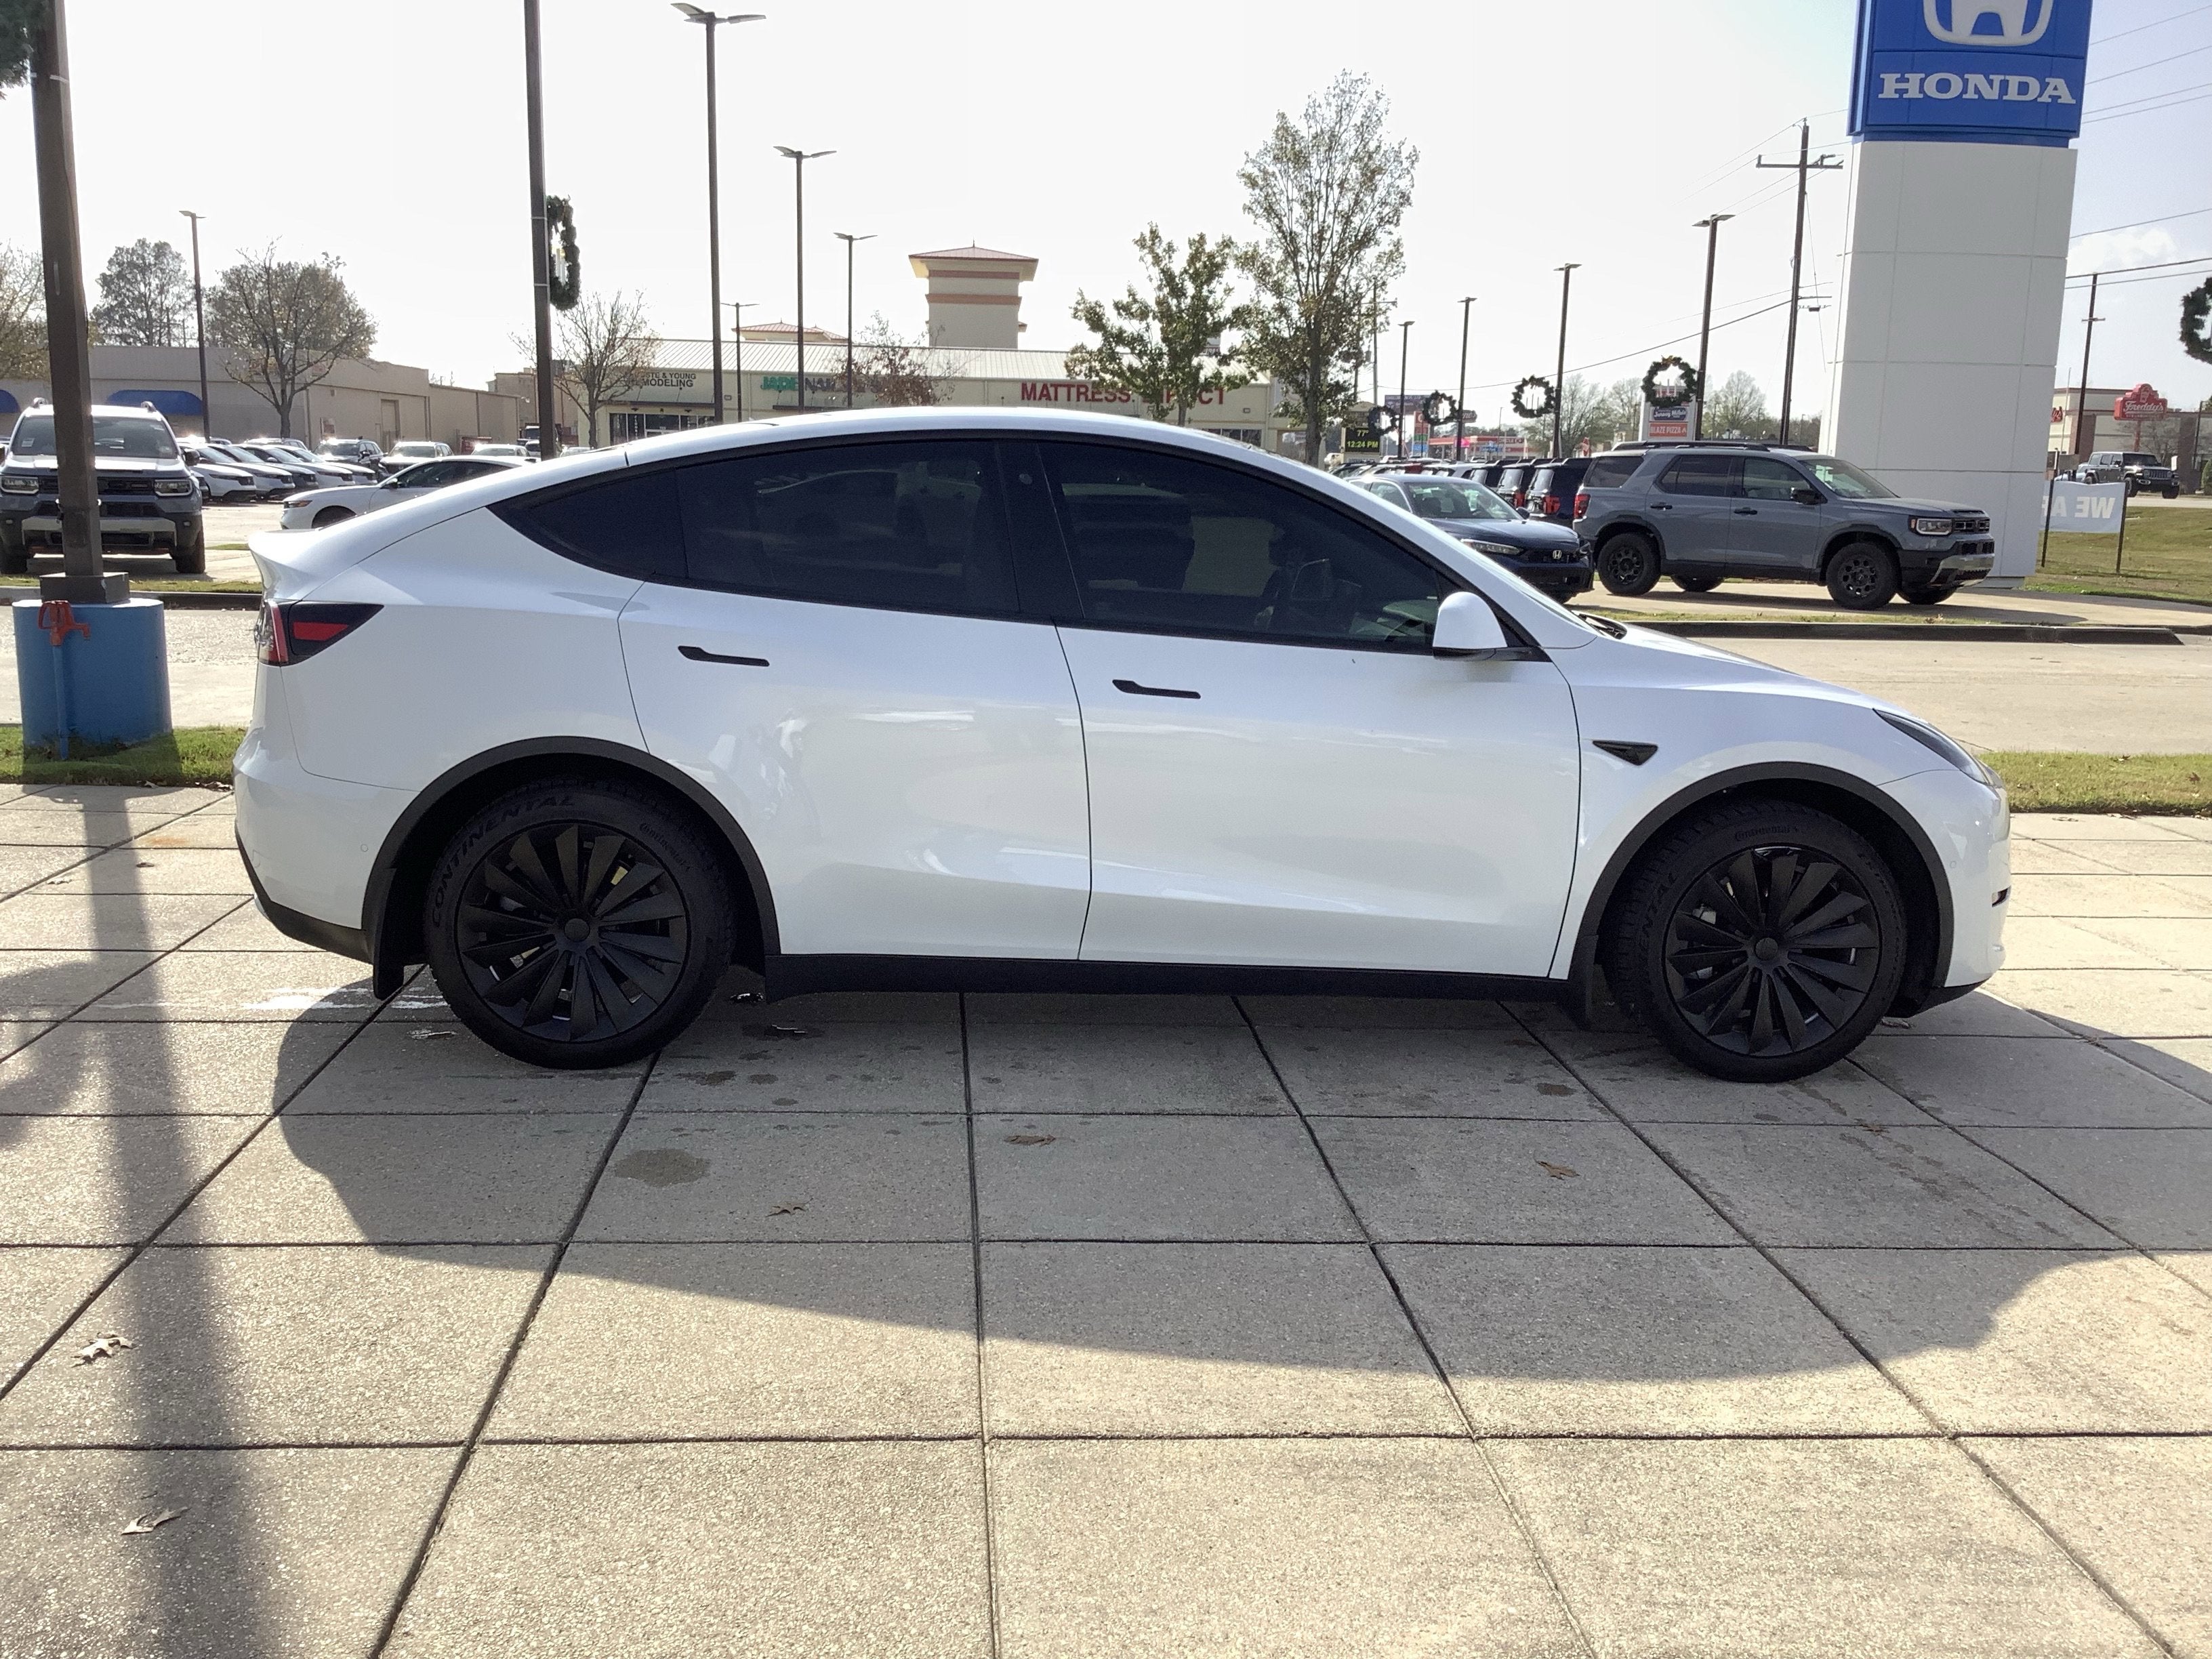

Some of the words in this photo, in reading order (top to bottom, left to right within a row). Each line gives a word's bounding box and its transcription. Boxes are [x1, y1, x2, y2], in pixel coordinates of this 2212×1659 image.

[1878, 73, 2076, 104] HONDA
[634, 377, 693, 387] MODELING
[1021, 382, 1131, 403] MATTRESS
[2123, 401, 2164, 413] Freddy's
[432, 795, 575, 927] CONTINENTAL
